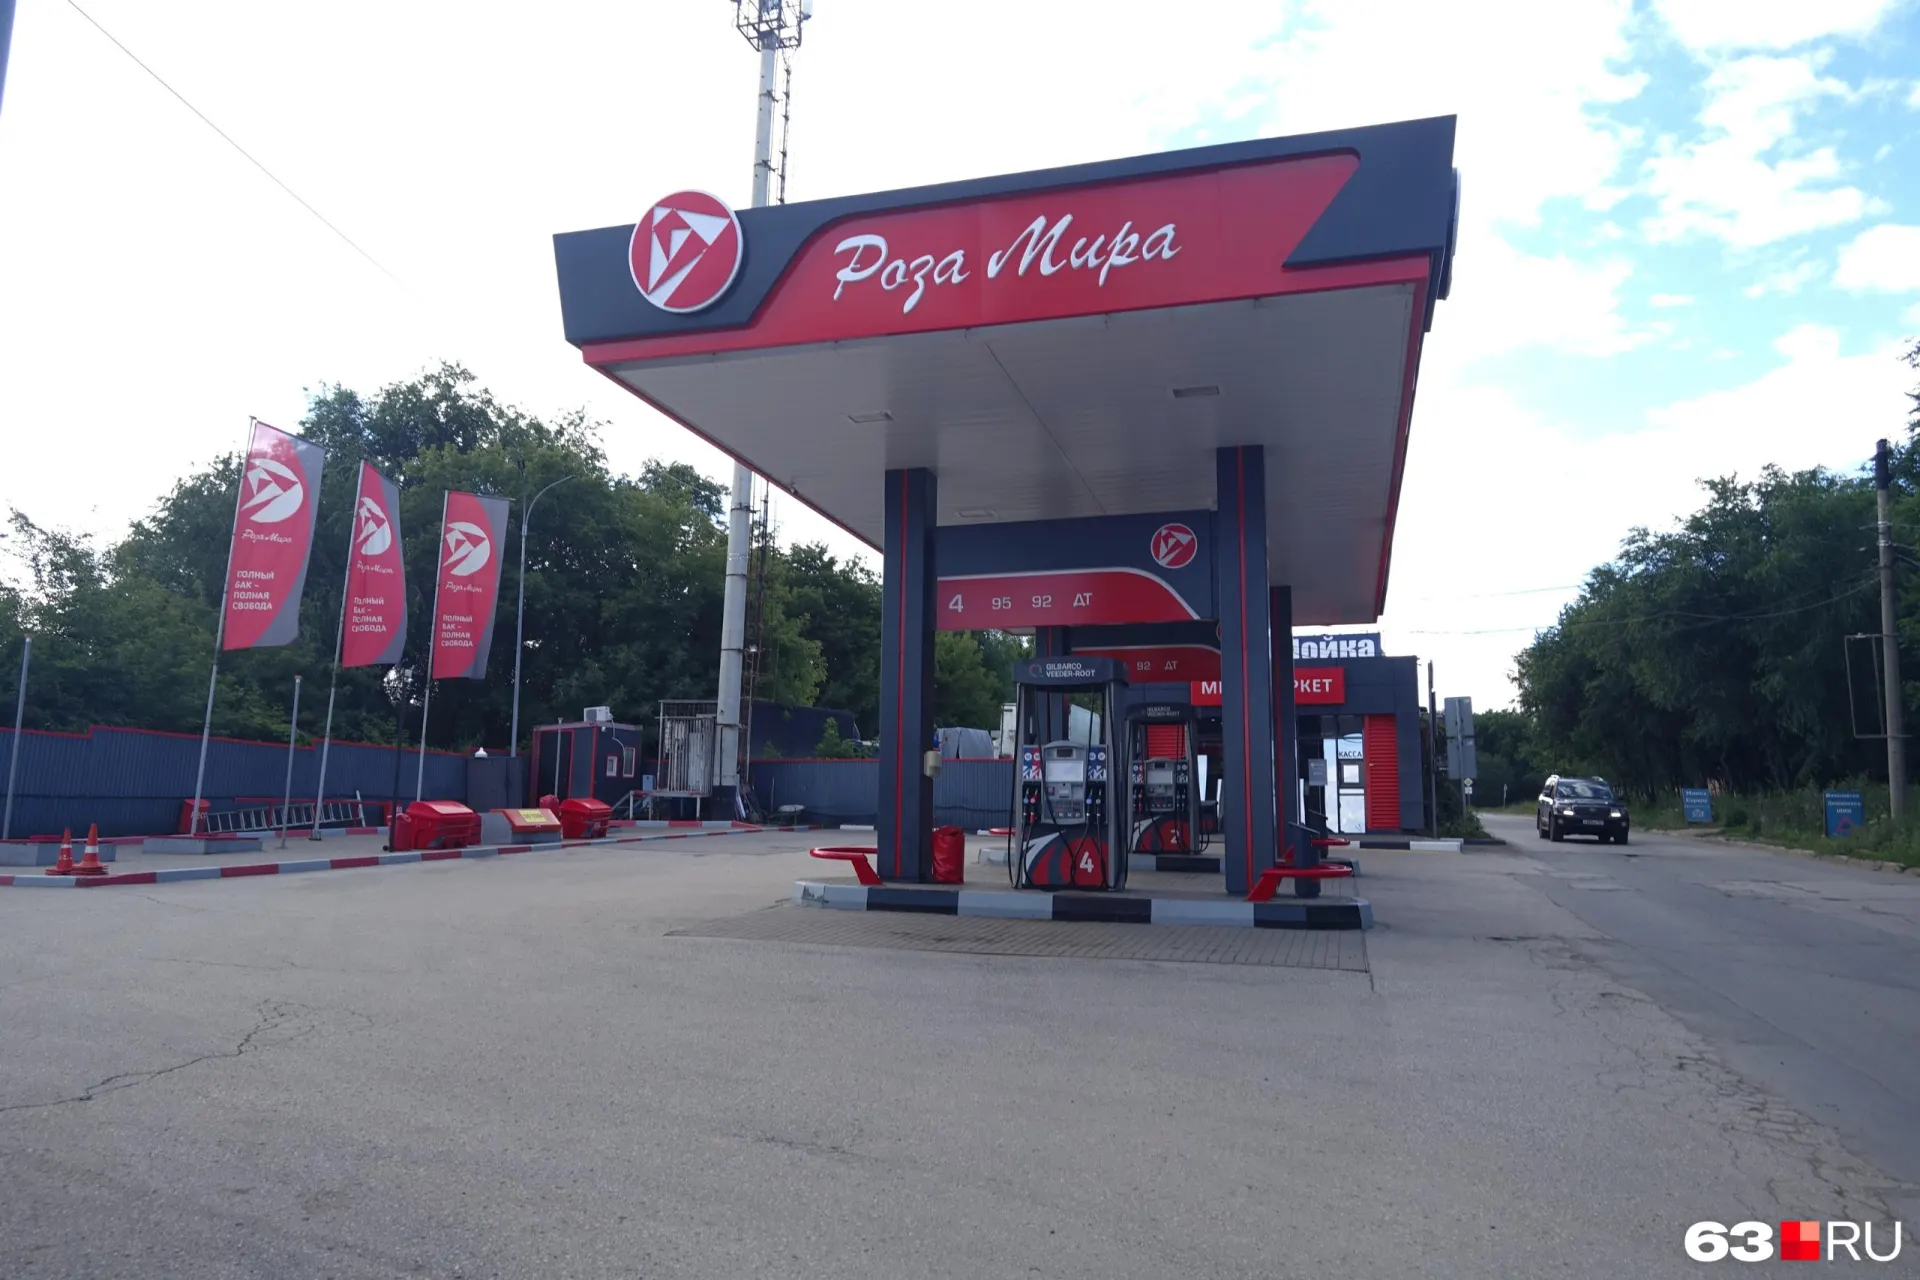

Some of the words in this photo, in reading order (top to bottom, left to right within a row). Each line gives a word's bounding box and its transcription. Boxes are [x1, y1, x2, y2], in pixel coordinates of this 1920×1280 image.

[834, 234, 970, 314] Роза
[987, 214, 1182, 287] Мира
[236, 571, 275, 579] ПОЛНЫЙ
[234, 581, 252, 589] БАК
[233, 592, 269, 600] ПОЛНАЯ
[232, 602, 272, 610] СВОБОДА
[949, 594, 963, 612] 4
[991, 597, 1011, 610] 95
[1032, 595, 1051, 608] 92
[1072, 593, 1092, 607] ДТ
[1046, 662, 1082, 670] GILBARCO
[1046, 669, 1096, 678] VEEDER-ROOT
[1338, 750, 1362, 758] КАССА
[1080, 851, 1094, 873] 4
